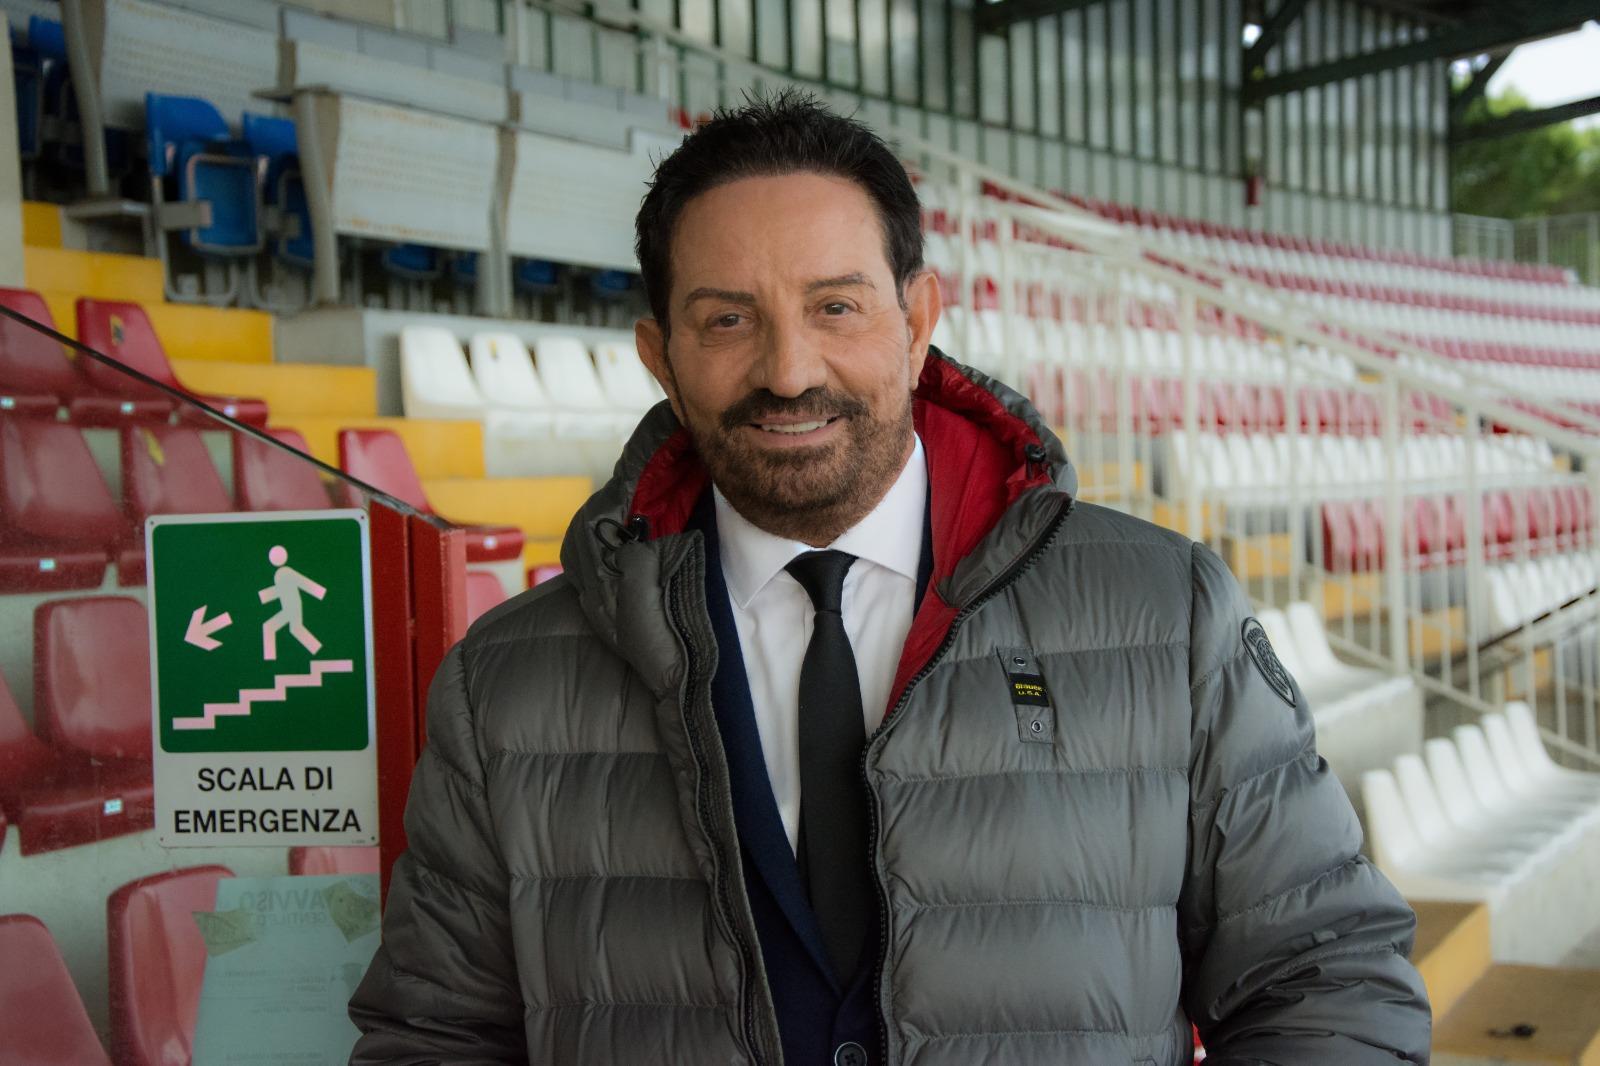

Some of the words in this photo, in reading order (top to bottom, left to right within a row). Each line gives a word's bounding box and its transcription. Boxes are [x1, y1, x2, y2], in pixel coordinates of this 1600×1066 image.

[197, 766, 295, 791] SCALA
[304, 766, 333, 790] DI
[174, 808, 362, 833] EMERGENZA
